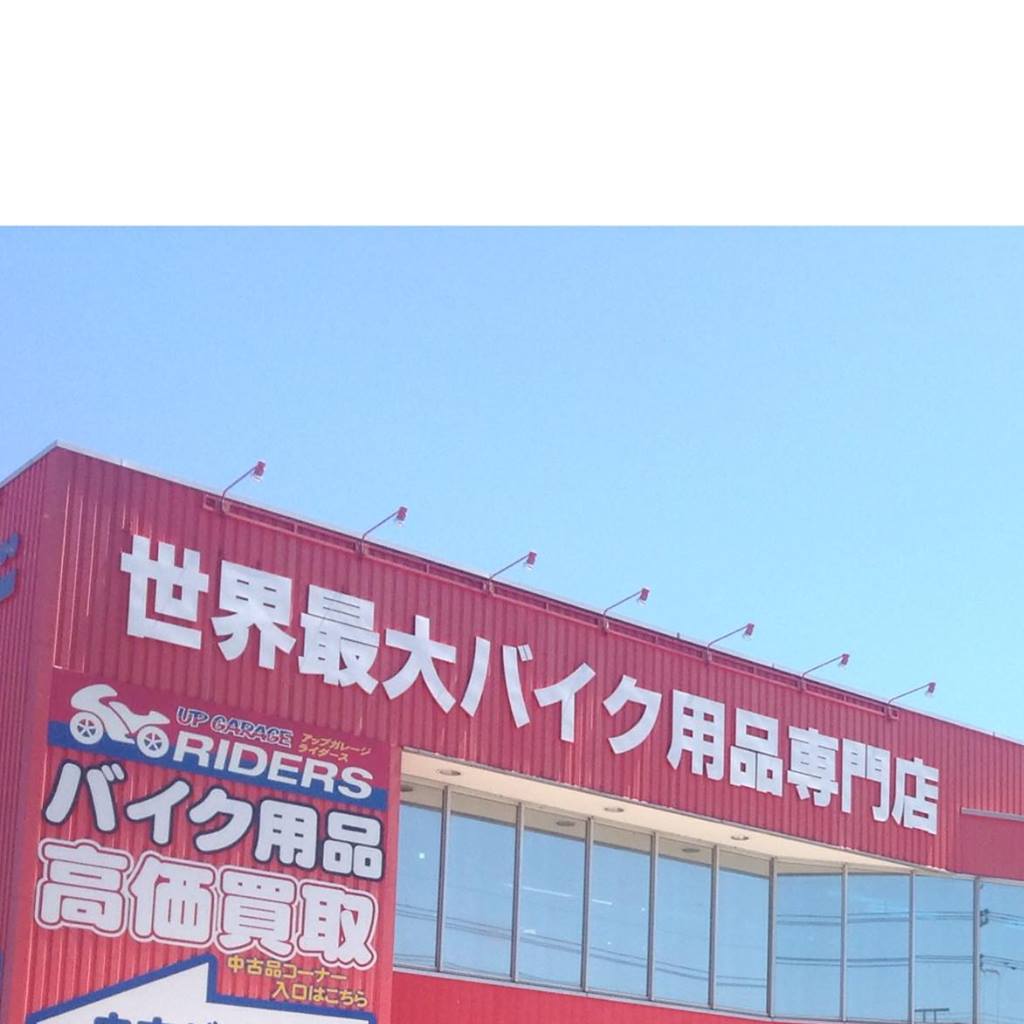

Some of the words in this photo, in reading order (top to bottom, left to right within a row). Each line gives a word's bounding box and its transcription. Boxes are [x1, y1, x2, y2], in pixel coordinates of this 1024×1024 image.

[120, 534, 939, 835] 世界最大バイク用品専門店
[177, 706, 209, 728] UP
[211, 715, 294, 748] GARAGE
[173, 730, 374, 800] RIDERS
[44, 760, 384, 880] バイク用品
[35, 837, 378, 969] 高価買取
[227, 954, 348, 982] 中古品コーナー
[272, 980, 369, 1008] 入口はこちら
